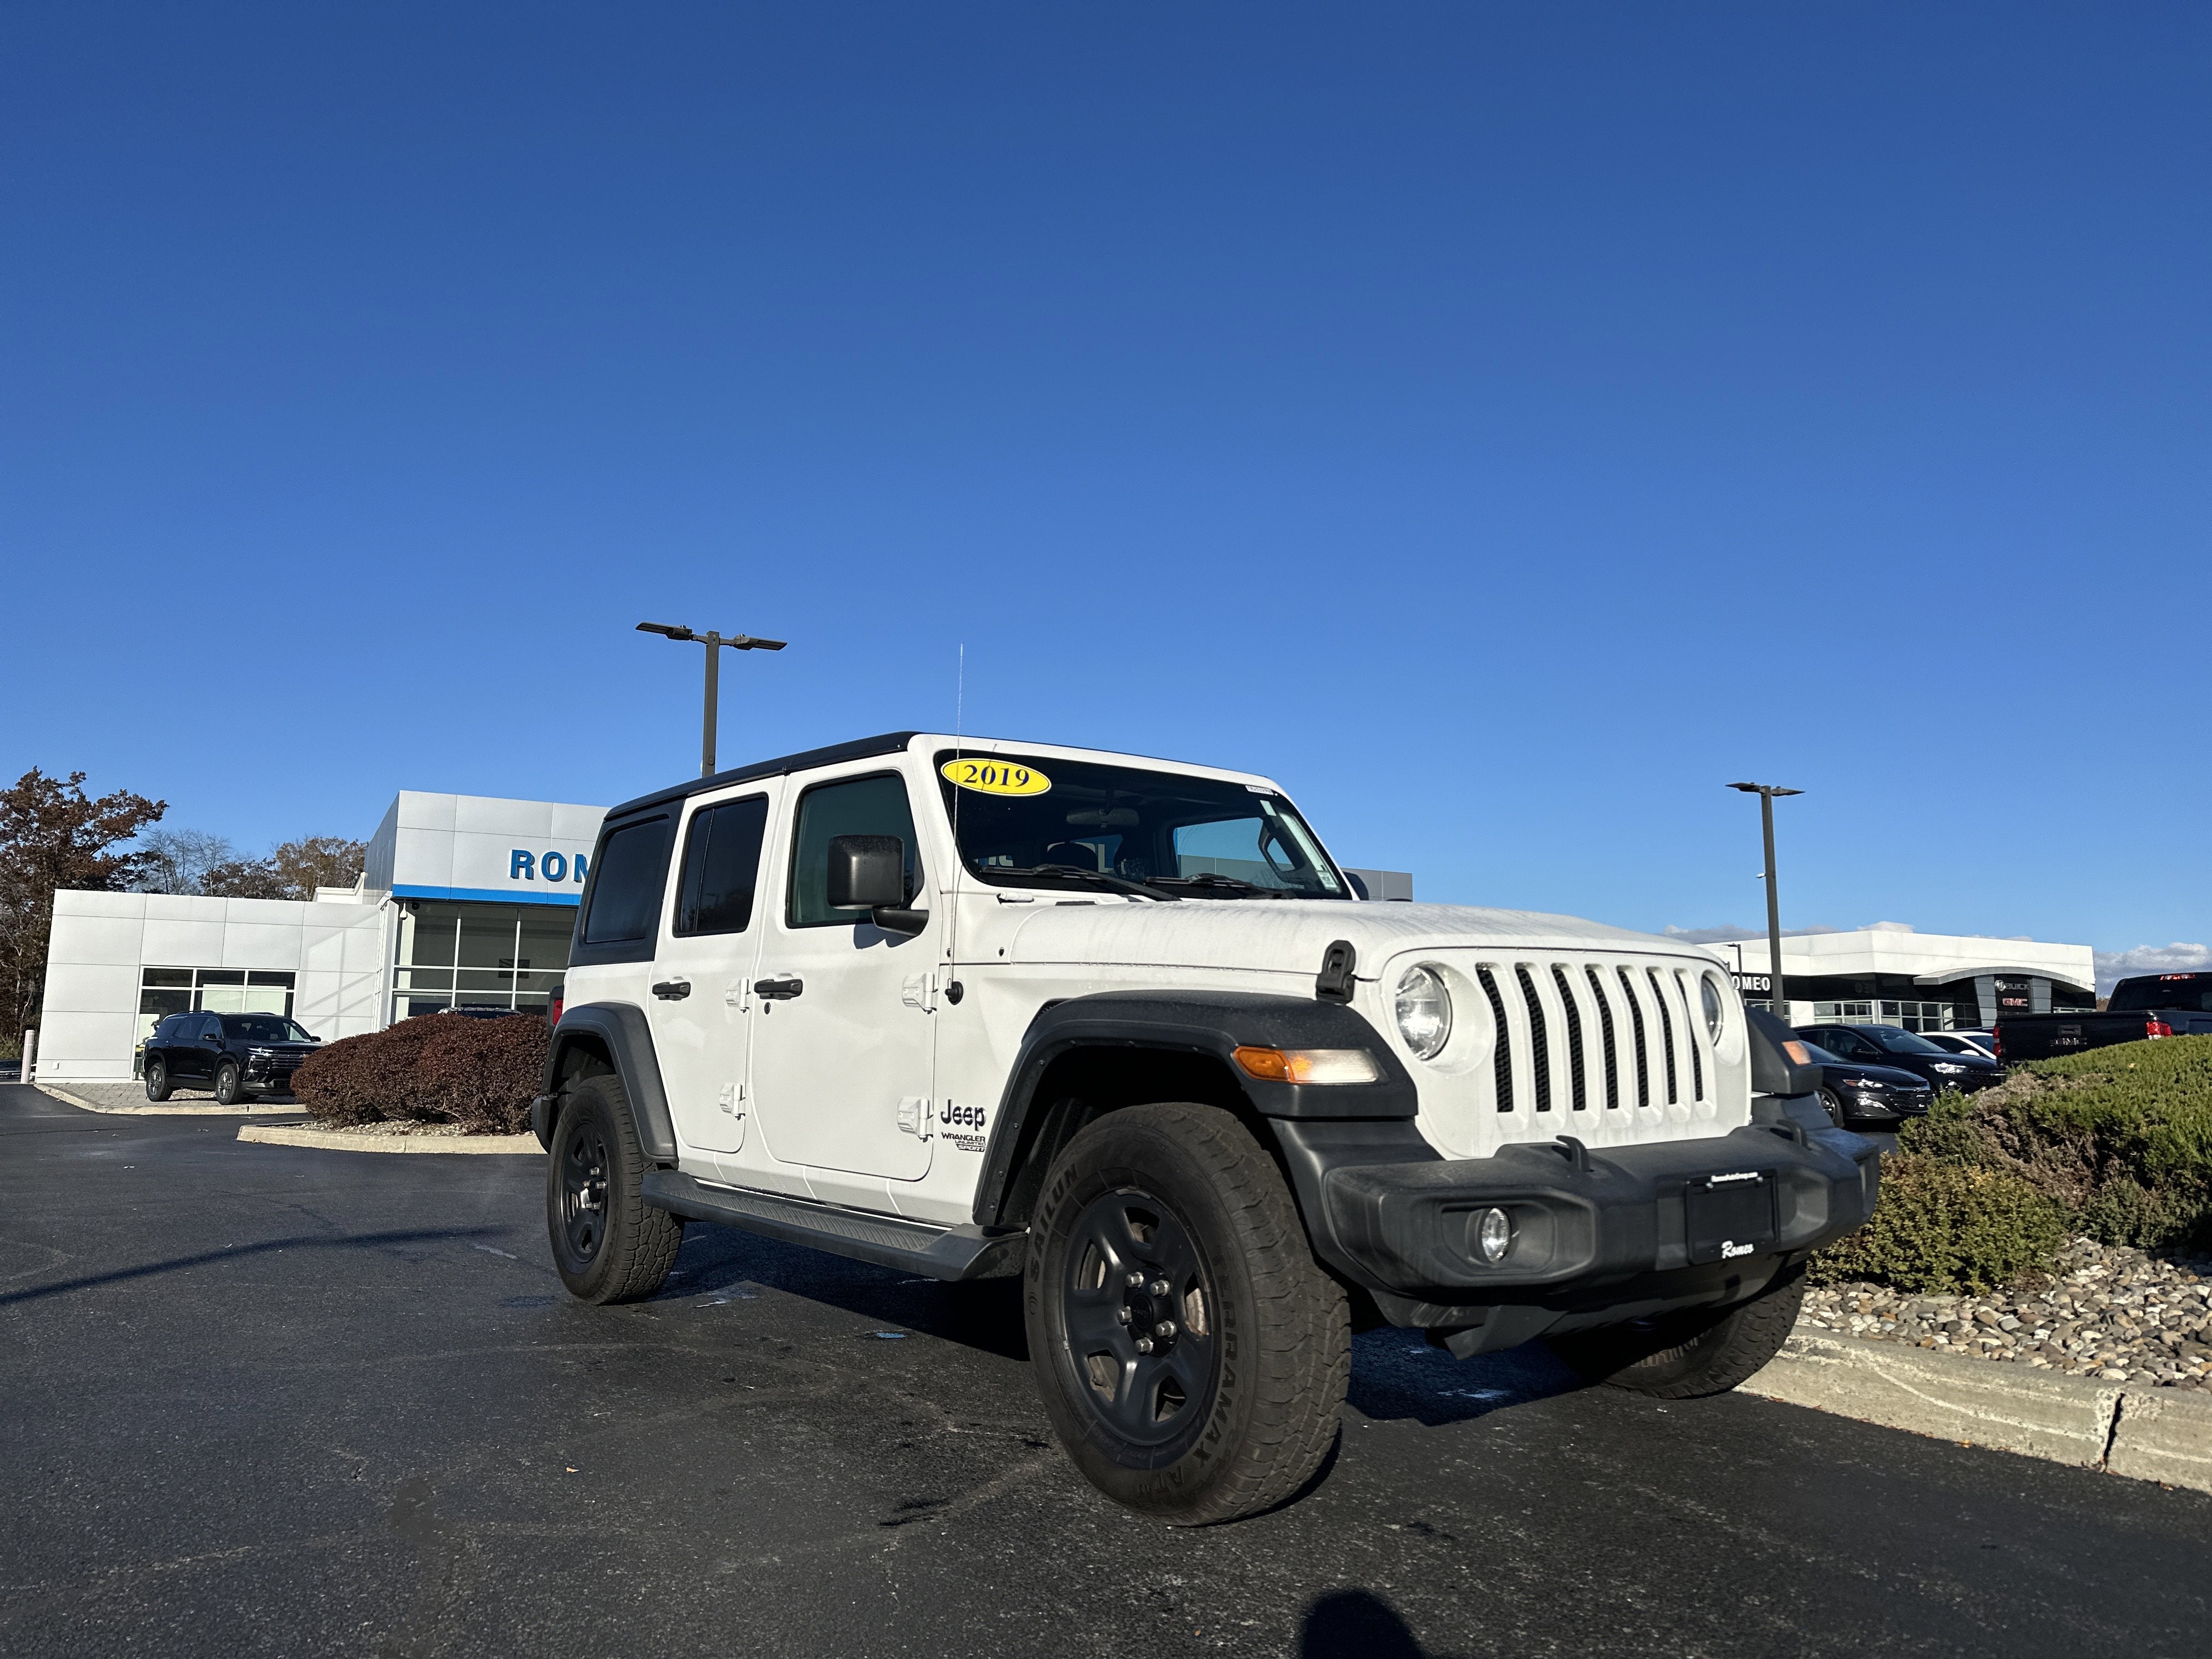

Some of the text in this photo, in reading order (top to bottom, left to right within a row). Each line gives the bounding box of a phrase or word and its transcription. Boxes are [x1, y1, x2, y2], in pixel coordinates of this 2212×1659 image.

[963, 764, 1029, 787] 2019
[2002, 998, 2028, 1007] GMC
[940, 1099, 987, 1131] Jeep
[941, 1132, 986, 1142] WRANGLER
[1030, 1163, 1079, 1283] SAILUN
[1721, 1240, 1754, 1259] Romeo
[1193, 1249, 1237, 1469] TERRAMAX
